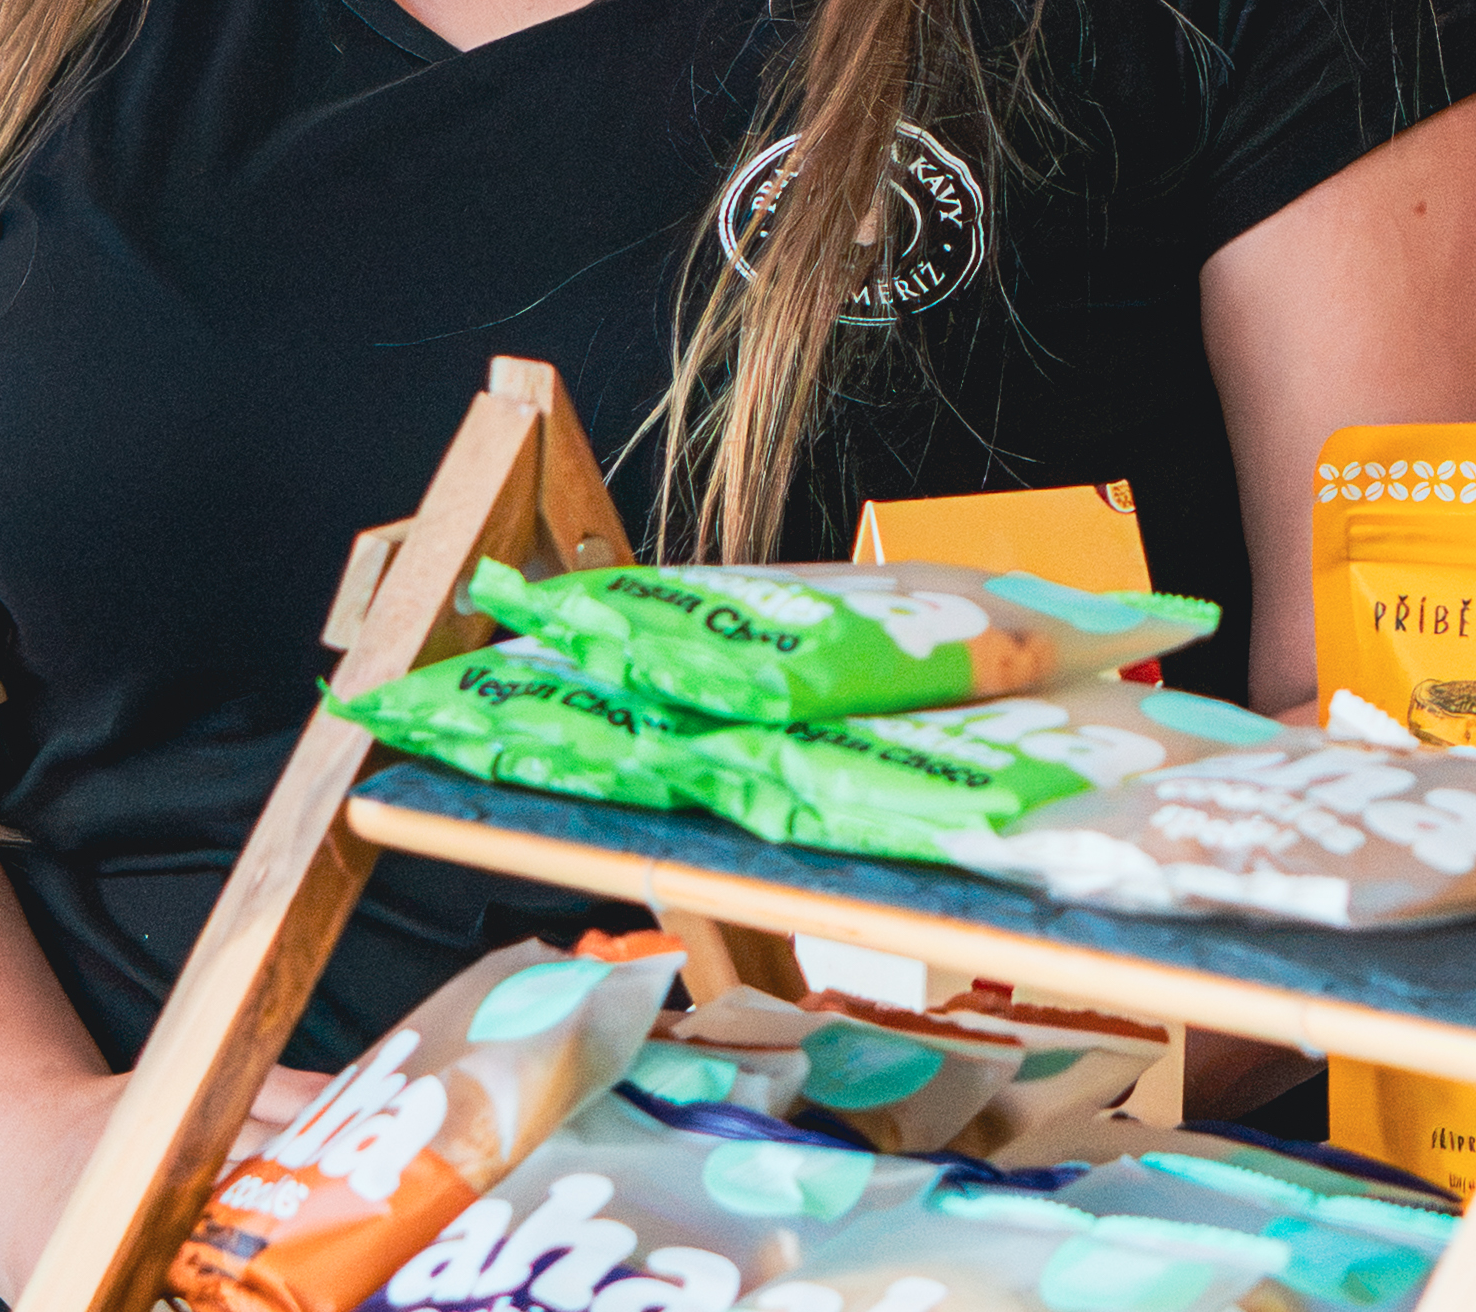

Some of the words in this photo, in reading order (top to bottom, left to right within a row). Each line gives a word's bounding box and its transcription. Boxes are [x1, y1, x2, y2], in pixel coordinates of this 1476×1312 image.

[908, 156, 964, 229] KÁVY
[847, 259, 947, 307] MĚŘÍŽ
[458, 666, 558, 707] Vegan
